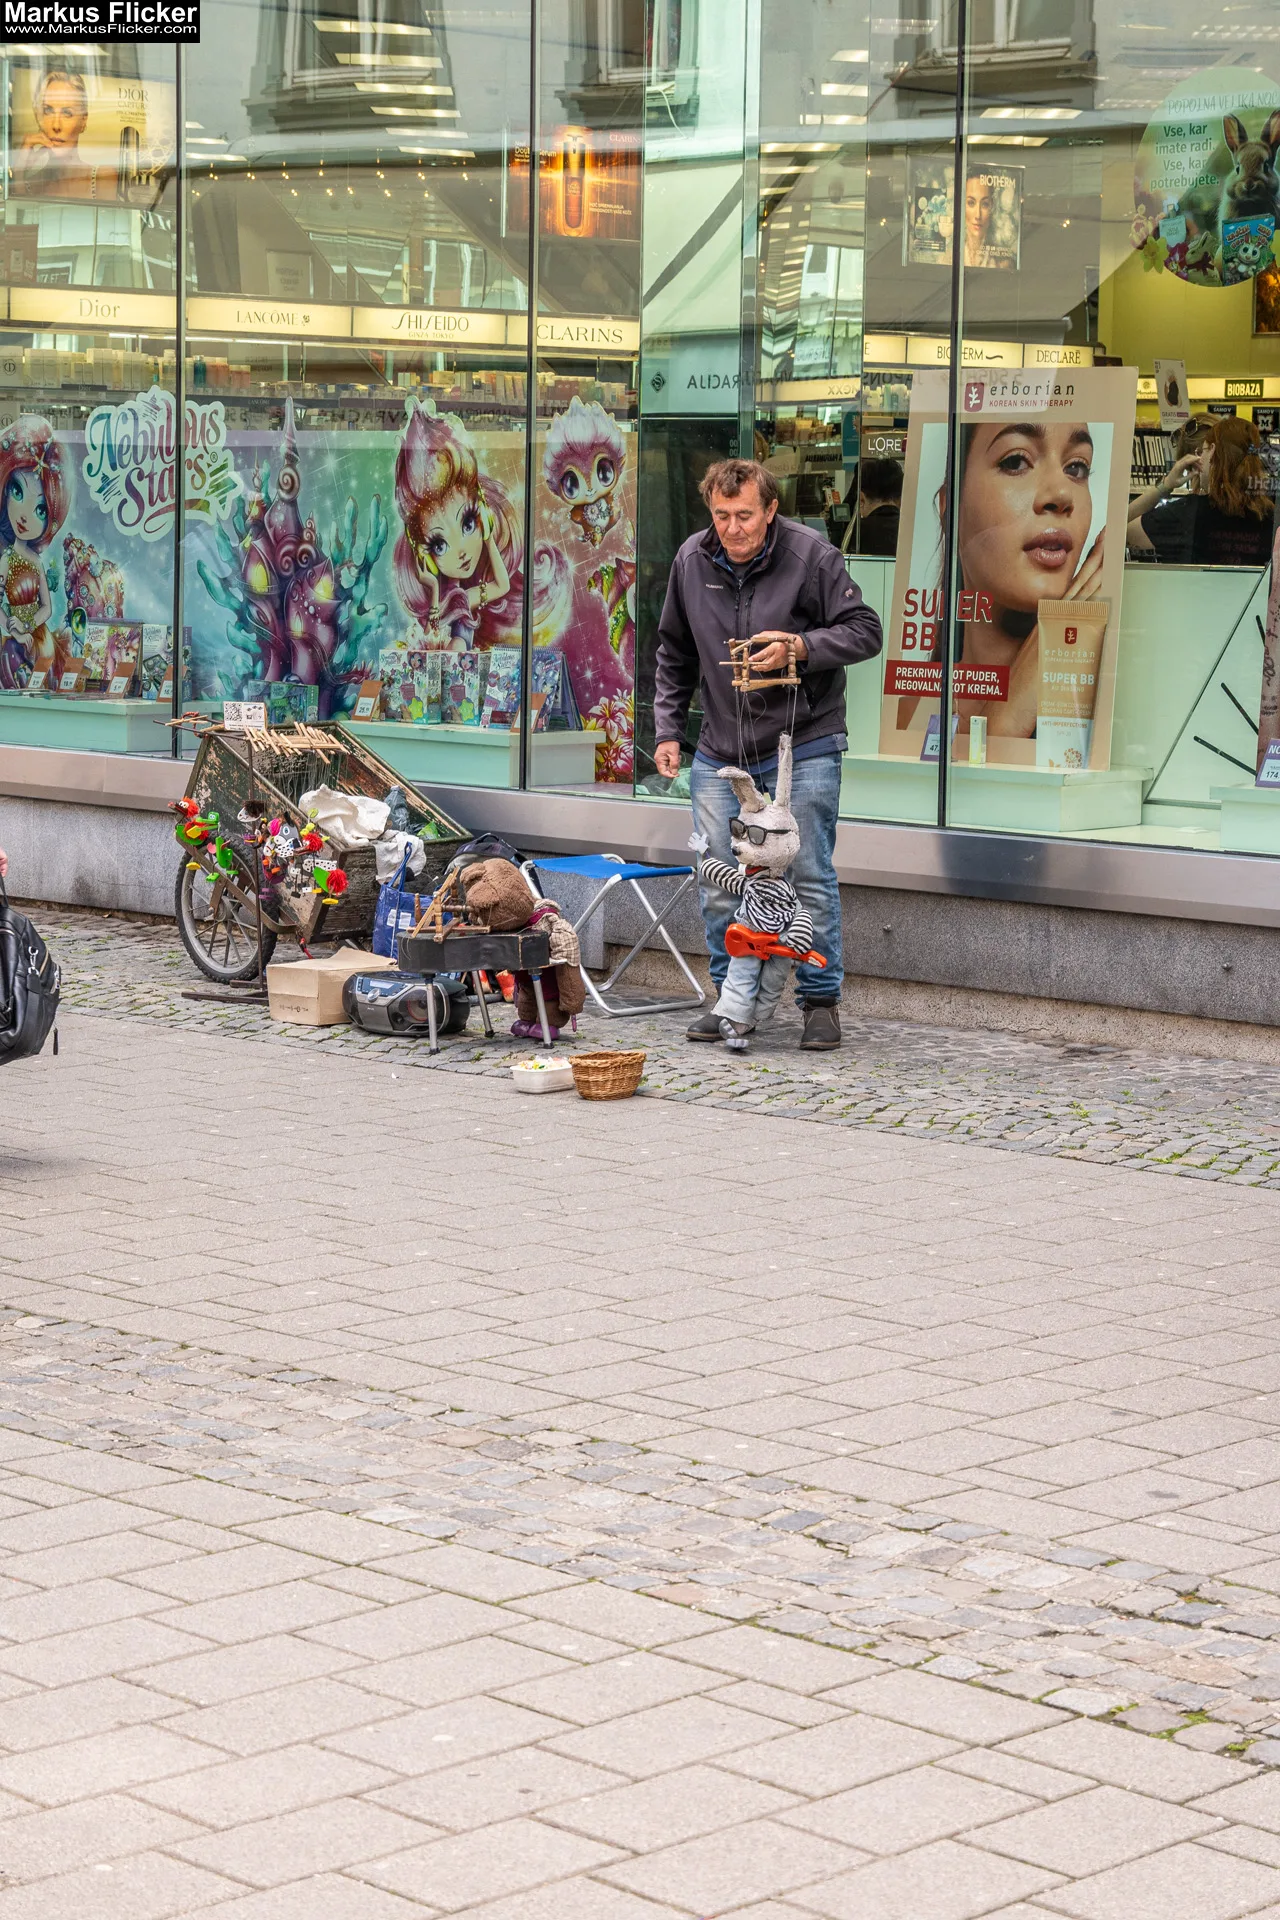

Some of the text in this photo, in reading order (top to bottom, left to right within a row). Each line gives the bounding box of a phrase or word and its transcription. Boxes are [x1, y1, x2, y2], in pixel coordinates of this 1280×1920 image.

[118, 87, 149, 102] DIOR
[1168, 96, 1216, 115] POPOLNA
[1164, 123, 1207, 138] Vse, kar
[1155, 138, 1215, 155] imate radi.
[1163, 157, 1207, 172] Vse, kar
[980, 174, 1016, 188] BIOTHERM
[1150, 173, 1220, 192] potrebujete.
[79, 298, 121, 318] Dior
[236, 309, 299, 325] LANCÔME
[392, 312, 469, 332] SHISEIDO
[408, 331, 429, 339] GINZA
[536, 324, 624, 344] CLARINS
[990, 380, 1075, 396] erborian
[1227, 383, 1261, 396] BIOBAZA
[901, 621, 937, 651] BB
[1044, 648, 1096, 658] erborian
[966, 671, 1000, 684] PUDER,
[1043, 671, 1095, 686] SUPER BB
[895, 680, 942, 692] NEGOVALN
[967, 683, 1003, 696] KREMA.
